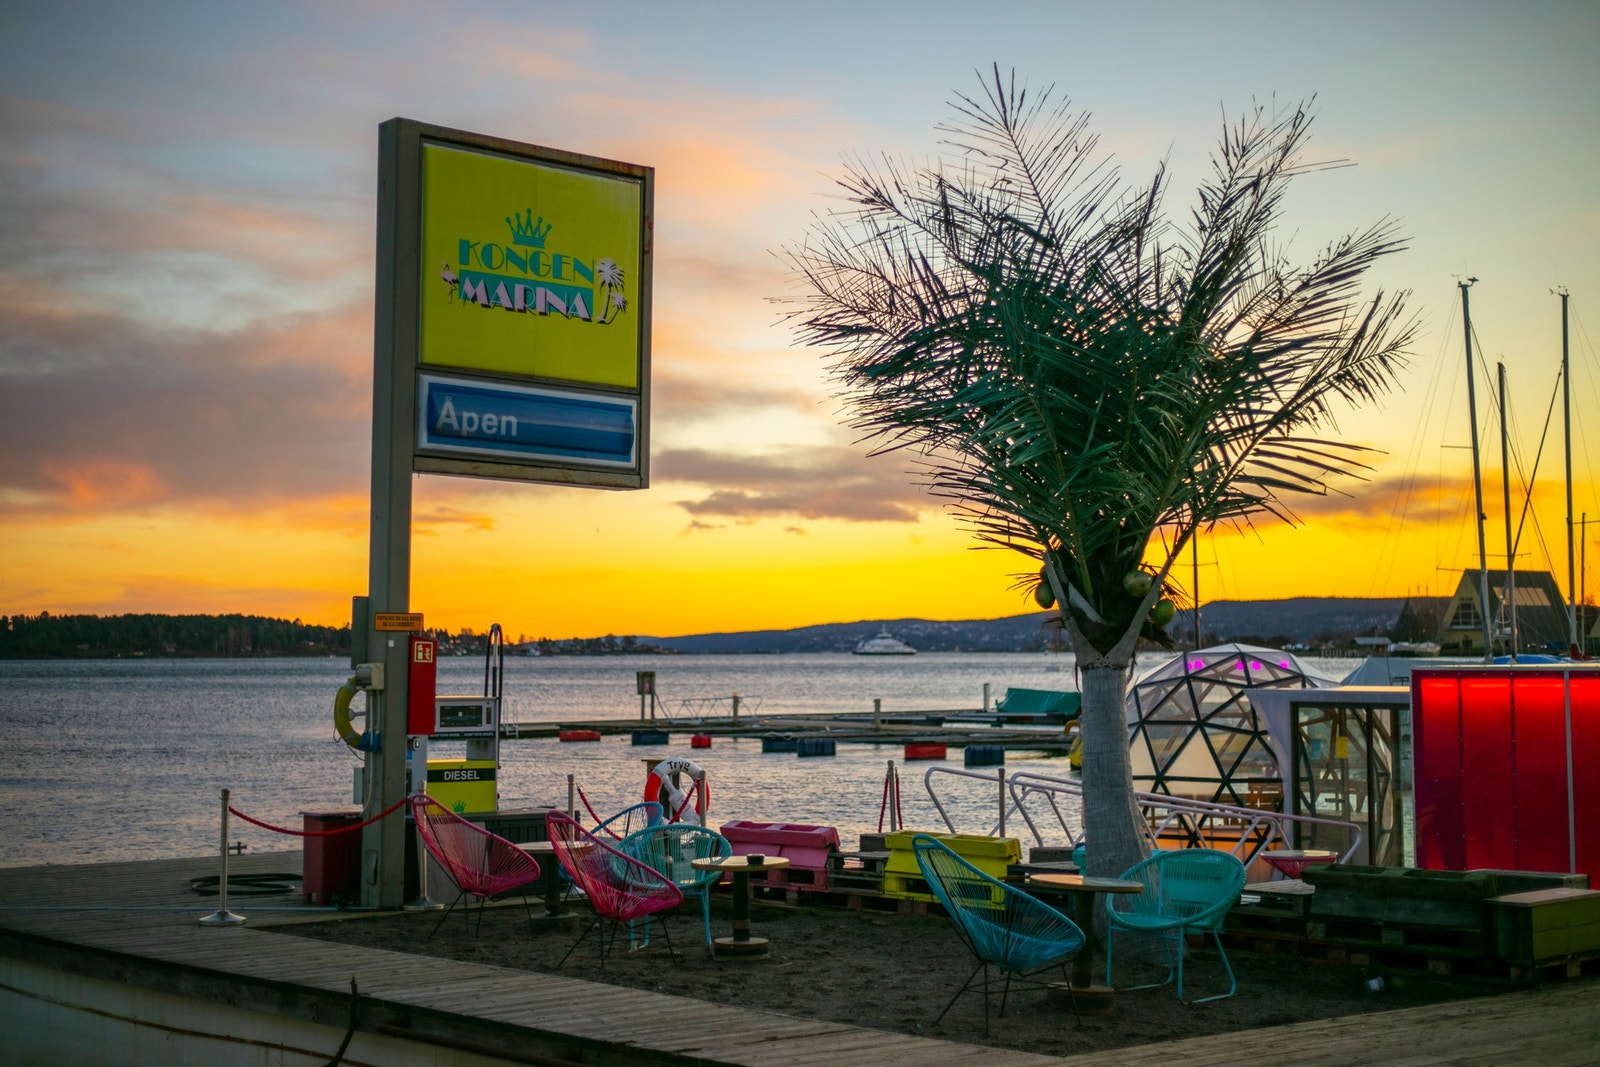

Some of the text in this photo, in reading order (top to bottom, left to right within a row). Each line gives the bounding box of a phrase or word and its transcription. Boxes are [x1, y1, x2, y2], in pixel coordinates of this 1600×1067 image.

[458, 238, 595, 284] KONGEN
[461, 276, 593, 322] MARINA
[435, 396, 518, 437] Åpen
[444, 770, 480, 780] DIESEL
[667, 760, 691, 772] Tryg
